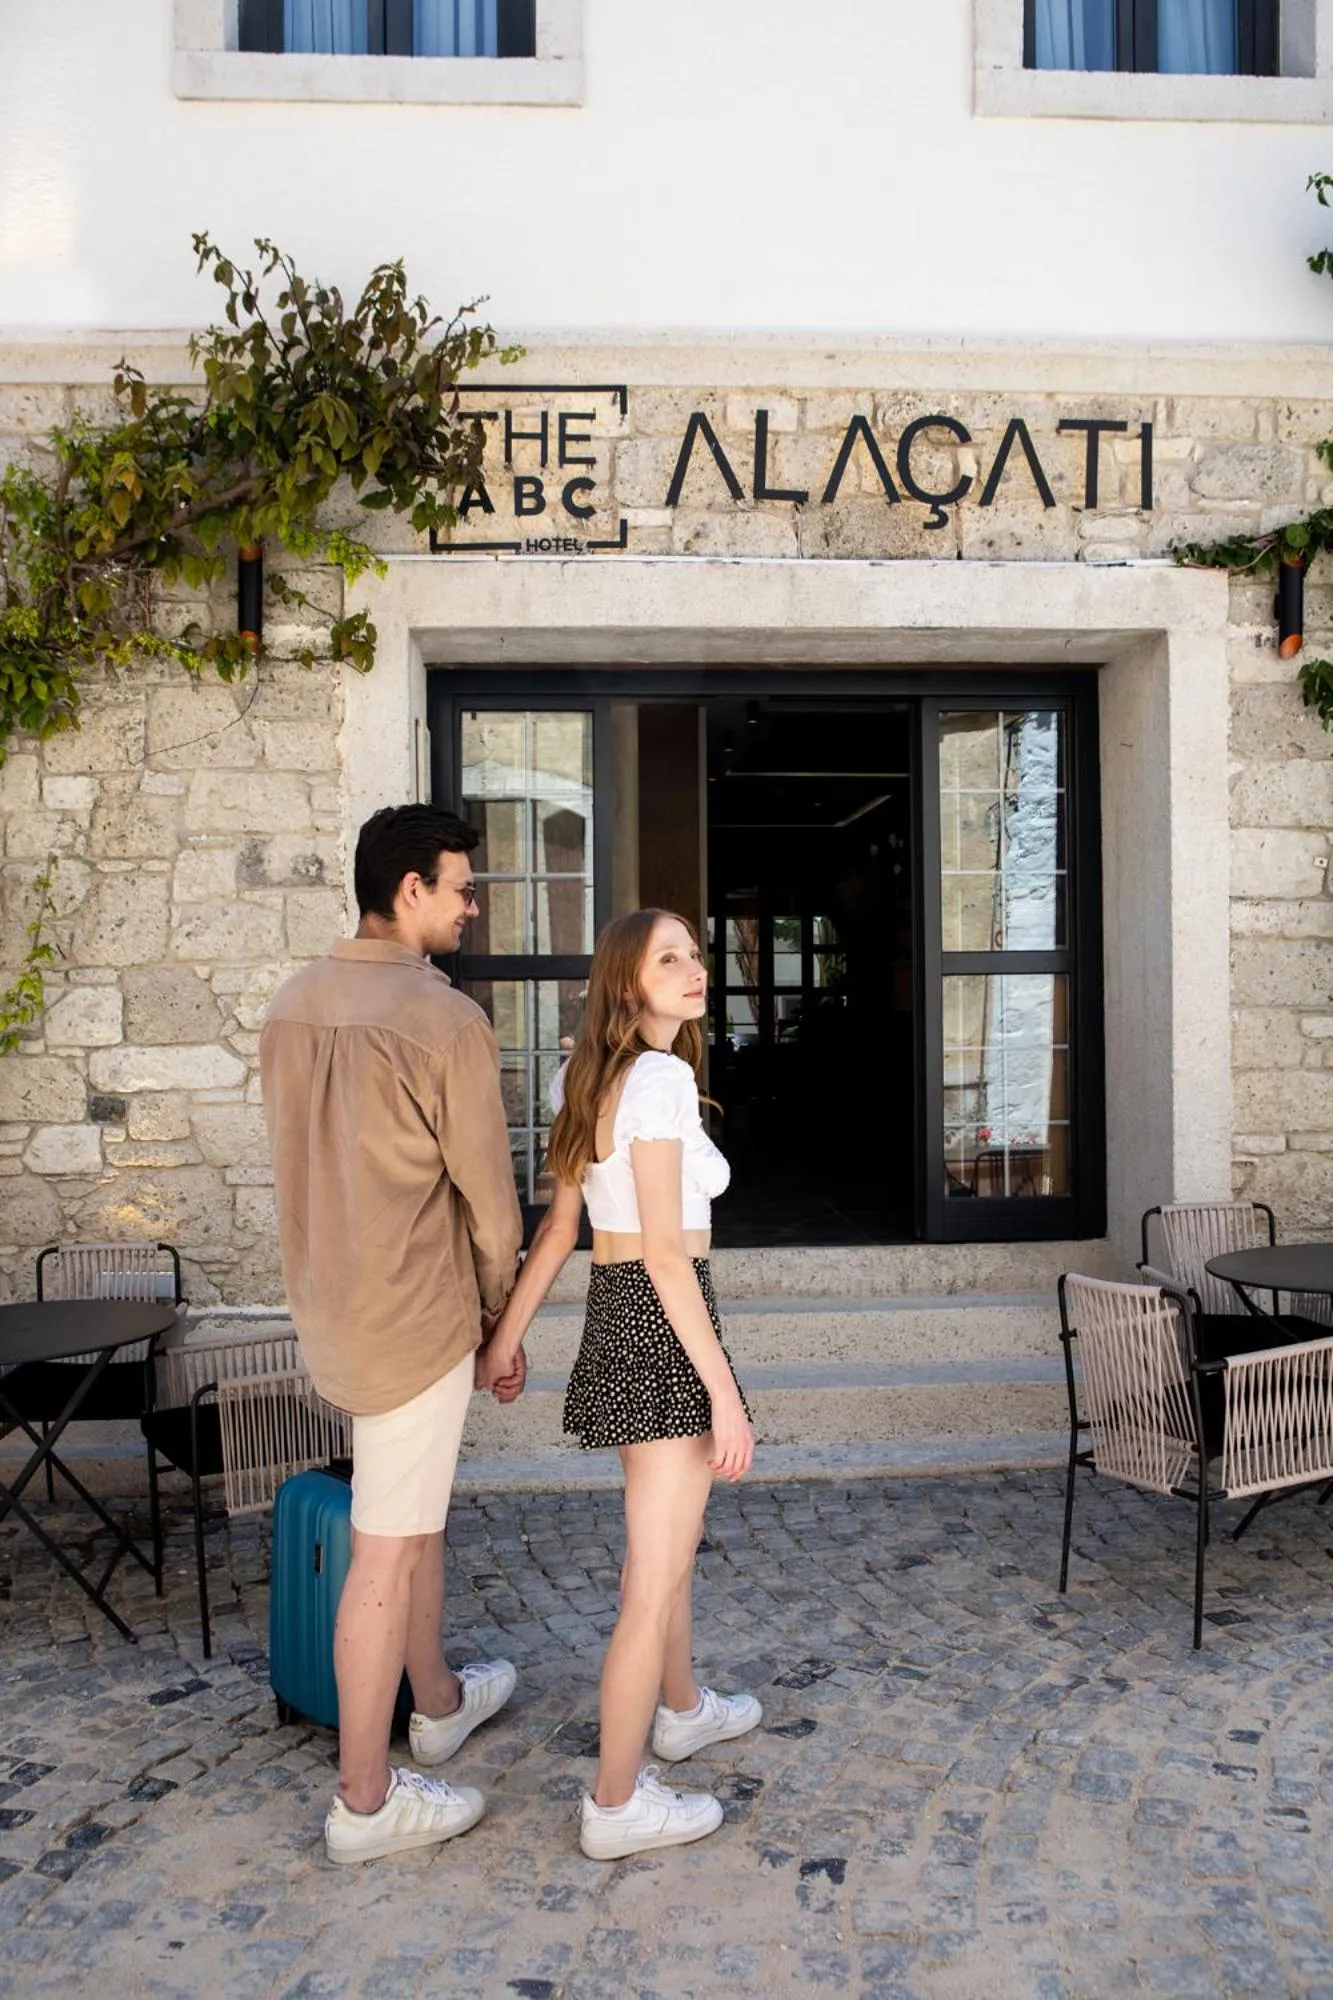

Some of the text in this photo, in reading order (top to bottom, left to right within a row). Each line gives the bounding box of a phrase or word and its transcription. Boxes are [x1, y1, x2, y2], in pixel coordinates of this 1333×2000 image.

[665, 408, 1153, 530] ALAÇATI
[457, 476, 597, 518] ABC
[526, 537, 583, 552] HOTEL
